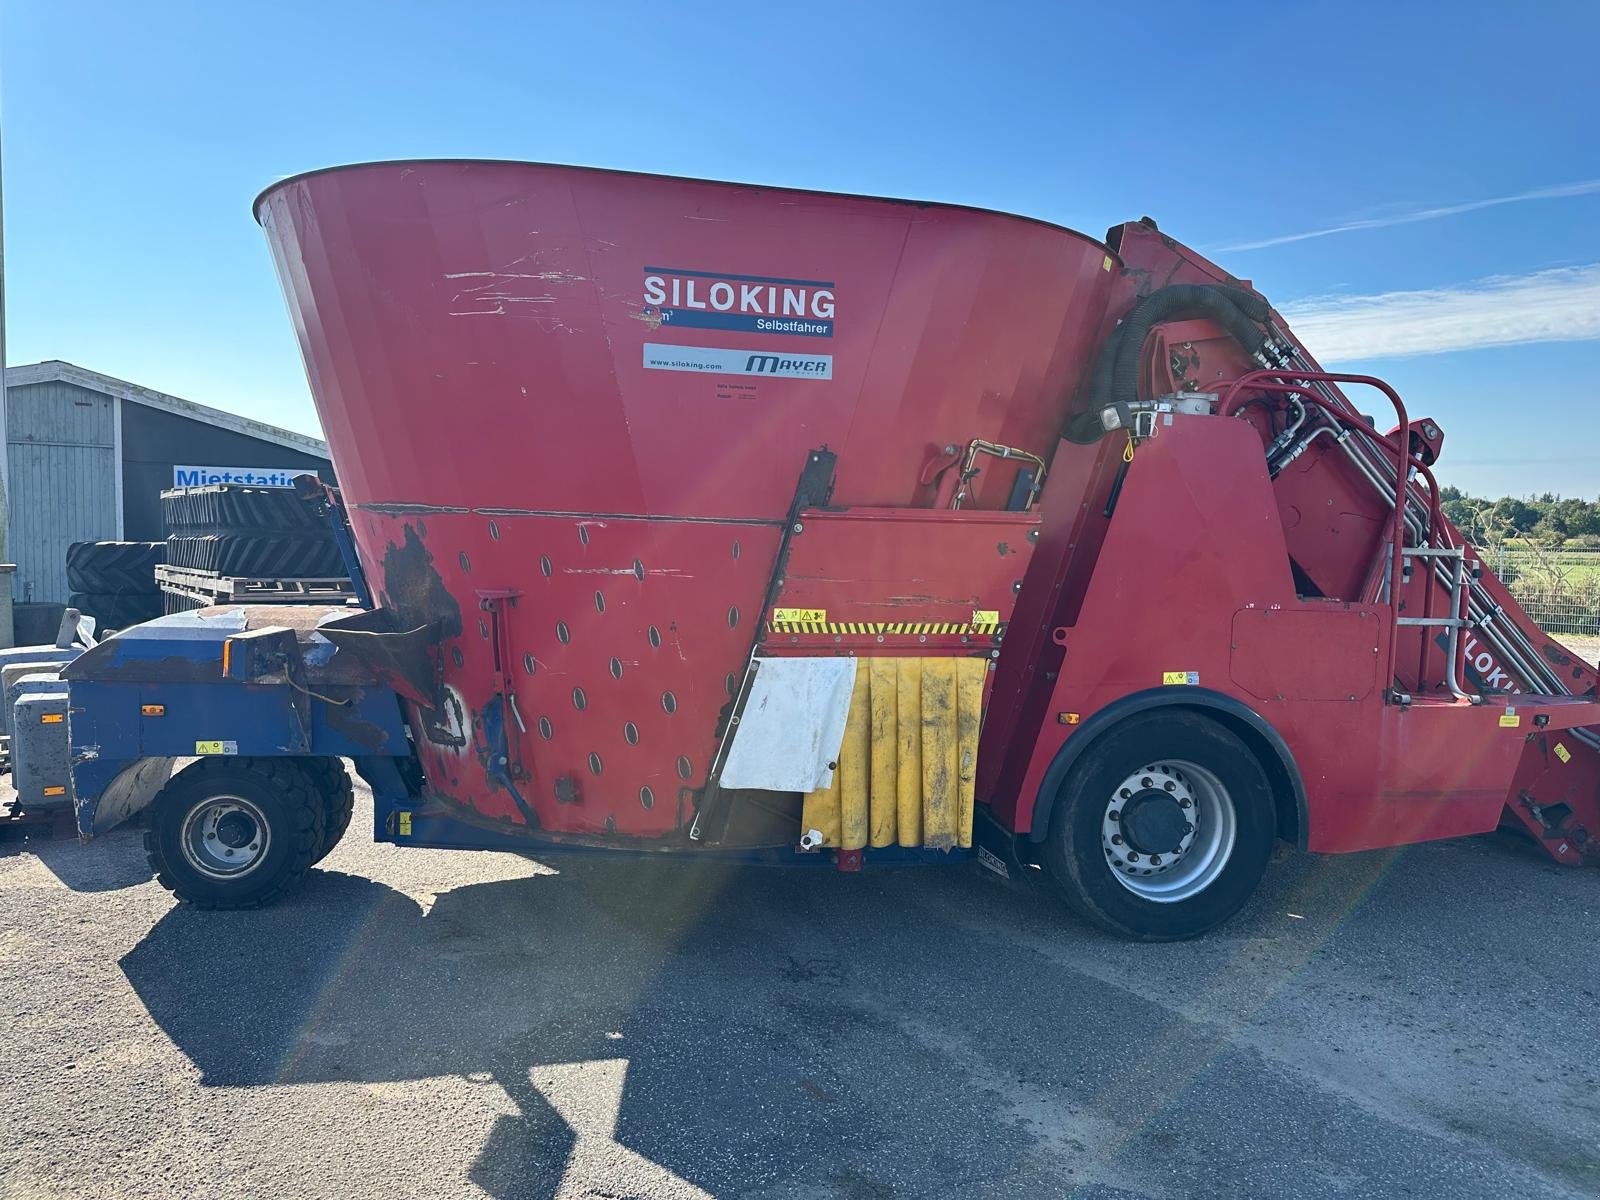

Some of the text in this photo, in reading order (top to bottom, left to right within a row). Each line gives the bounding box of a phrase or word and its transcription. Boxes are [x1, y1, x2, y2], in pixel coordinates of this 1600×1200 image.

[644, 276, 835, 318] SILOKING
[757, 318, 828, 334] Selbstfahrer
[650, 358, 722, 371] www.siloking.com
